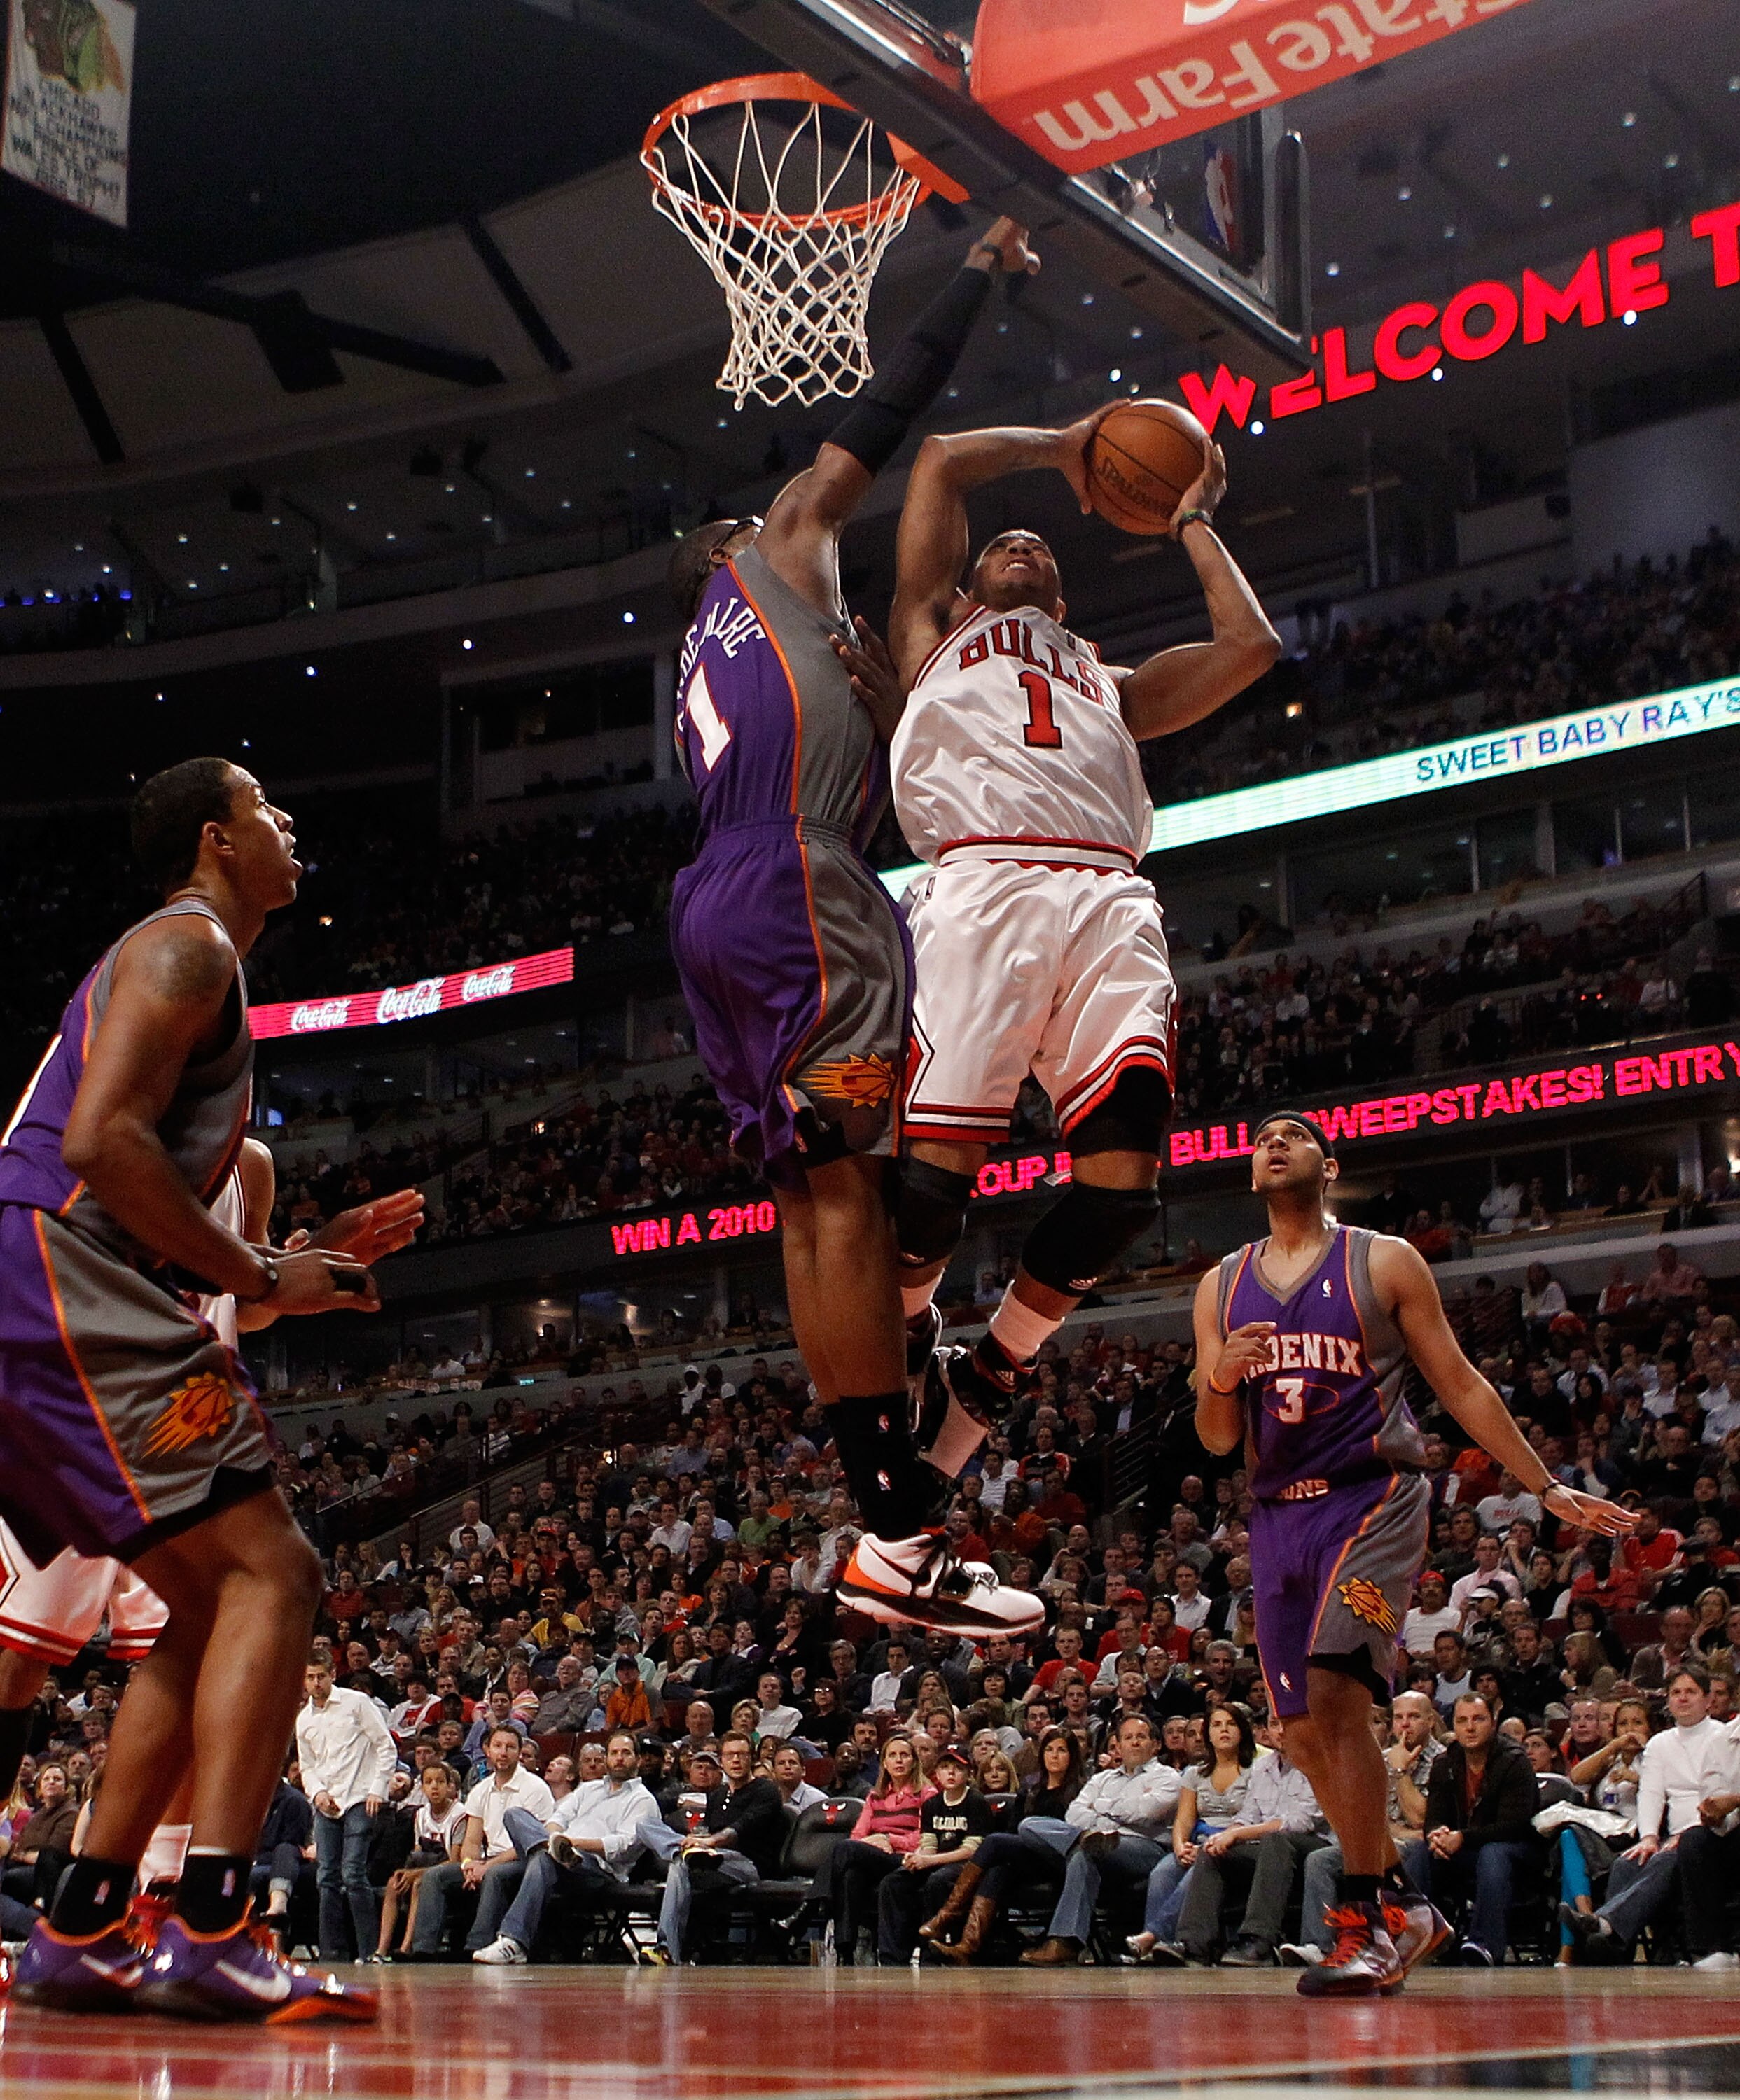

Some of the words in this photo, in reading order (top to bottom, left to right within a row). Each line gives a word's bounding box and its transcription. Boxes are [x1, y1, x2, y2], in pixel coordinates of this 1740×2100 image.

[1032, 41, 1281, 150] Farm
[959, 619, 1104, 706] BULLS
[685, 660, 734, 773] 1
[1018, 669, 1063, 750] 1
[1417, 735, 1528, 782] SWEET
[1538, 711, 1631, 756] BABY
[1643, 686, 1740, 732] RAY'S
[376, 976, 445, 1024] Coca-Cola
[611, 1217, 671, 1254] WIN
[676, 1213, 702, 1245] A
[707, 1201, 776, 1240] 2010
[1170, 1122, 1258, 1166] BULL
[1275, 1377, 1307, 1424] 3
